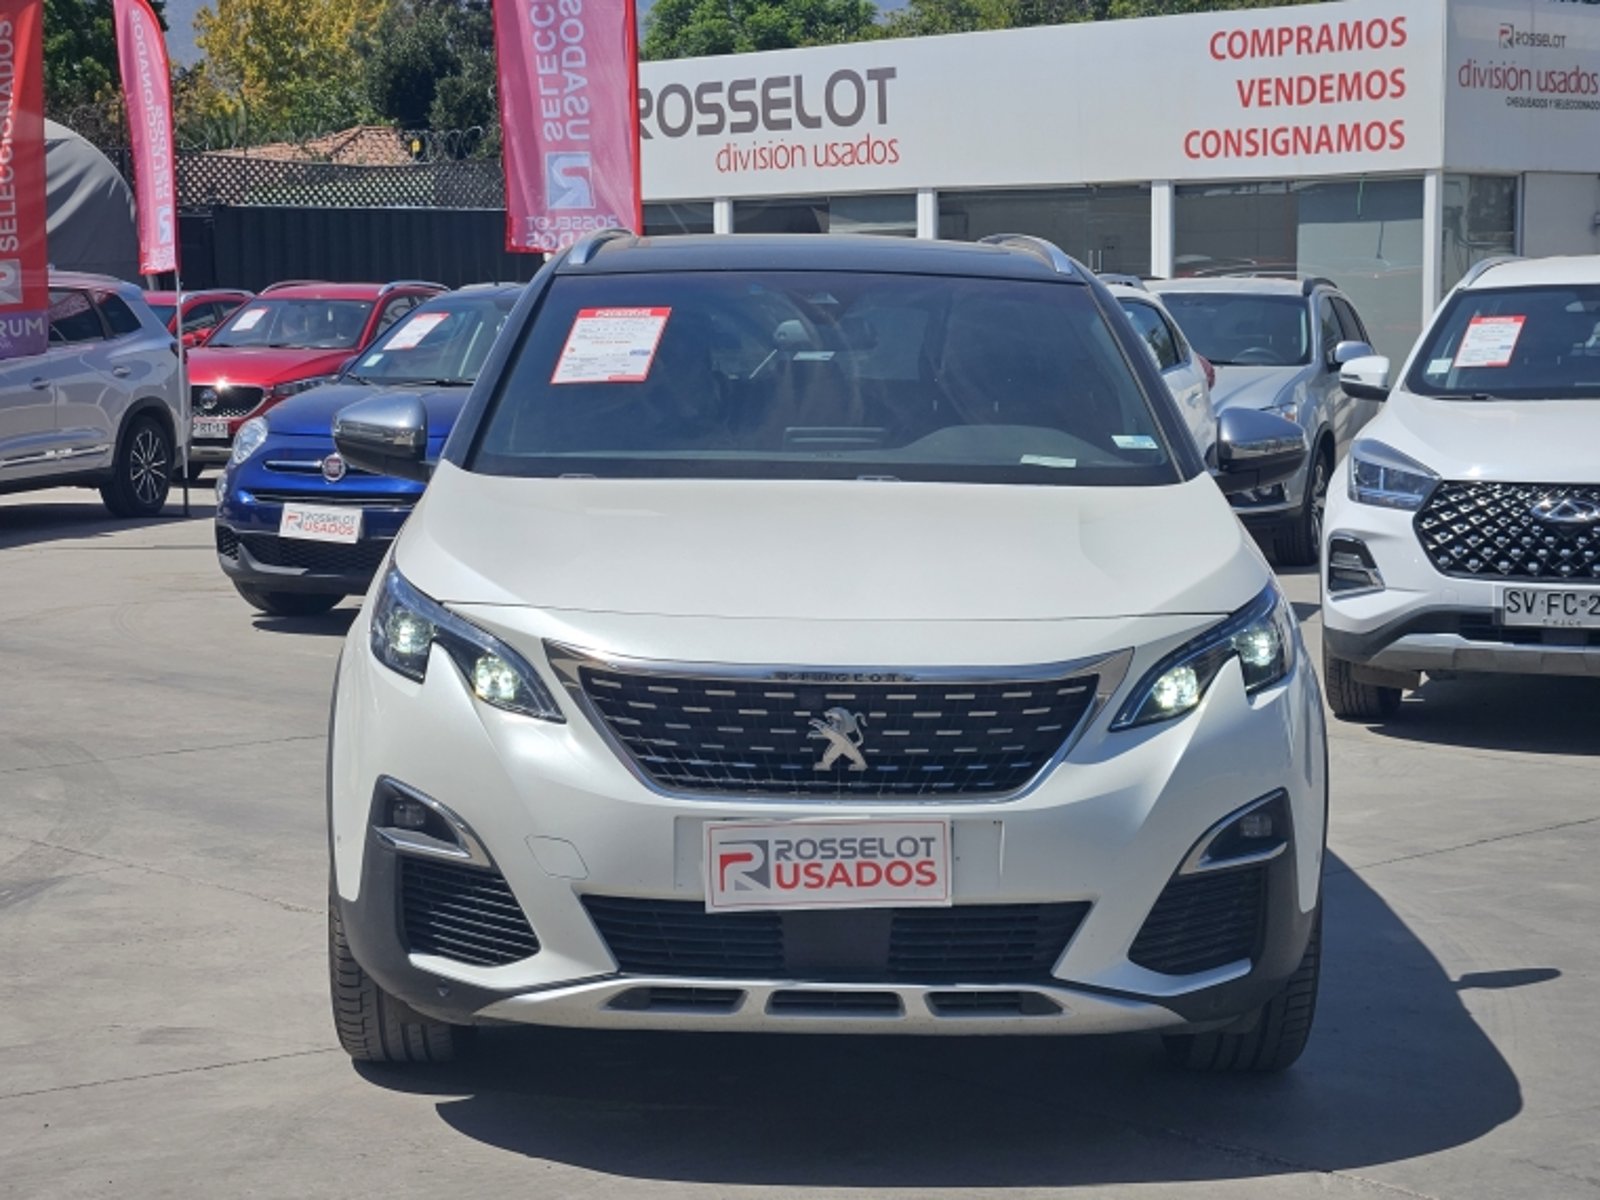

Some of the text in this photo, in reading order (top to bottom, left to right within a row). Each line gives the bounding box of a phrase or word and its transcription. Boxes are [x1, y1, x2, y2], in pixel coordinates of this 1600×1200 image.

[1209, 16, 1407, 60] COMPRAMOS
[1515, 31, 1567, 48] ROSSELOT
[1237, 68, 1407, 108] VENDEMOS
[1536, 64, 1599, 95] usados
[814, 133, 900, 168] usados
[1184, 119, 1406, 159] CONSIGNAMOS
[304, 521, 355, 536] USADOS
[774, 836, 936, 861] ROSSELOT
[775, 860, 937, 890] USADOS
